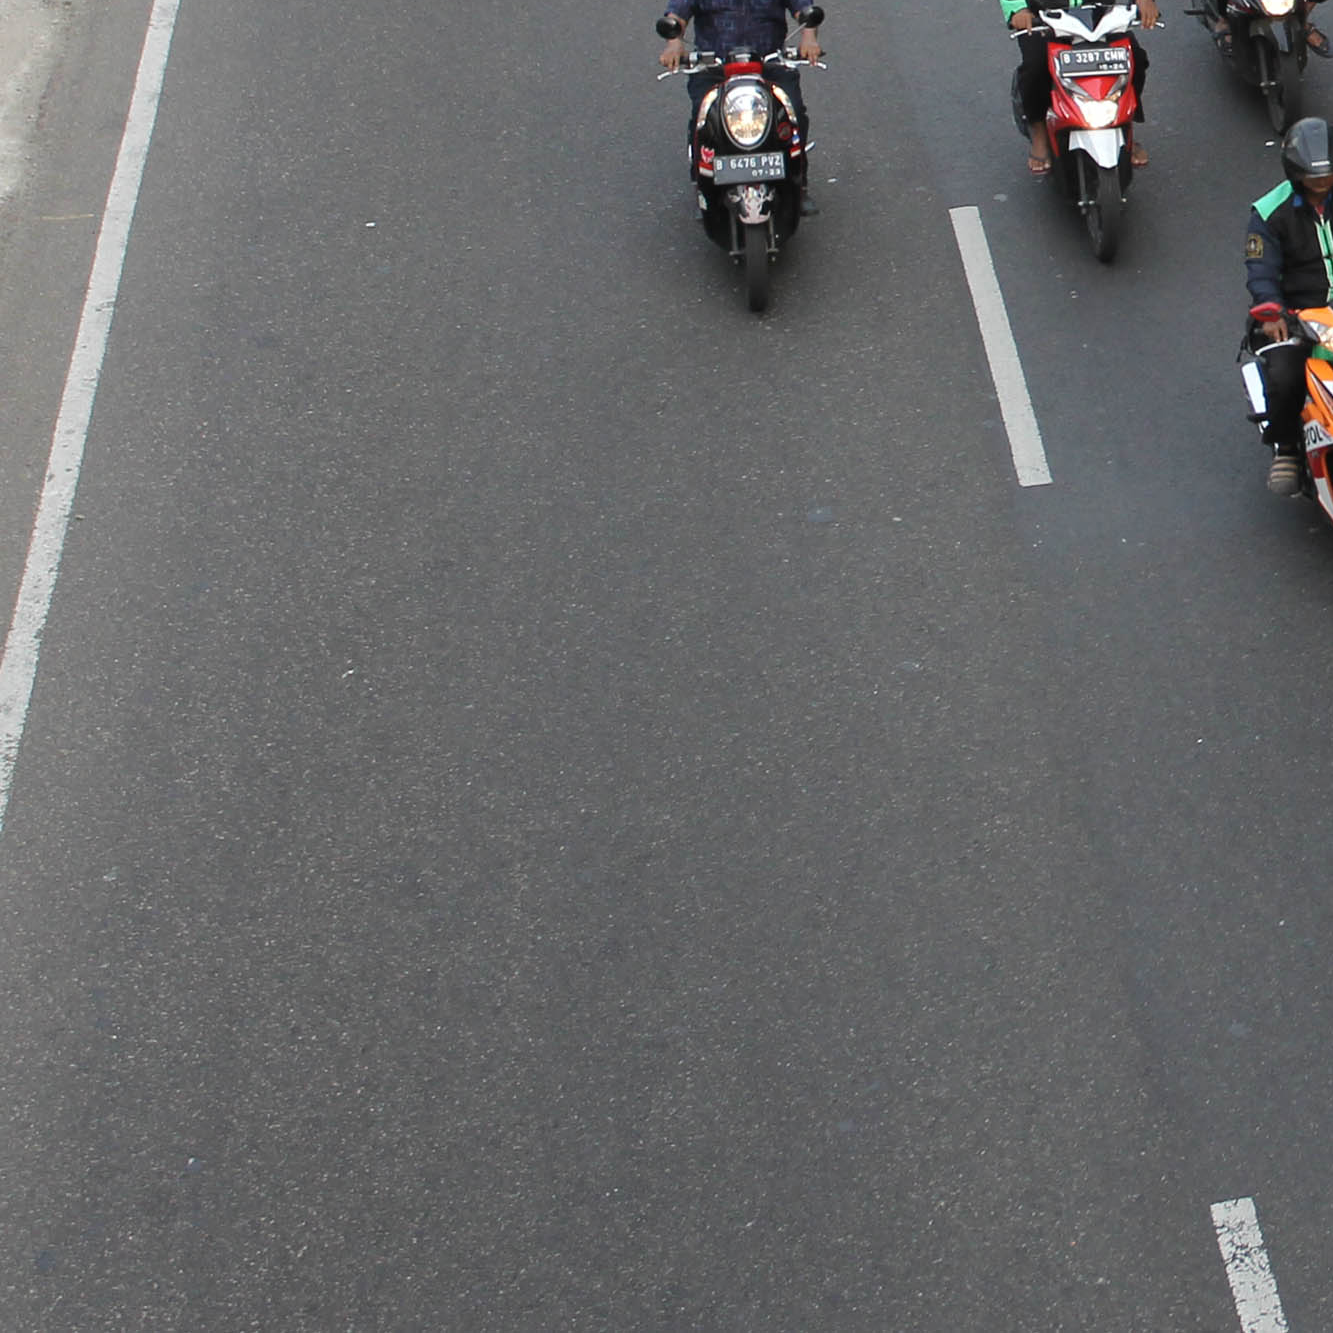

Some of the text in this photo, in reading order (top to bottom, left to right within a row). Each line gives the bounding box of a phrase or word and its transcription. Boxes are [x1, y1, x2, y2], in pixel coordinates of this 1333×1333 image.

[1063, 53, 1071, 64] B
[716, 154, 781, 171] B 6476 PVZ
